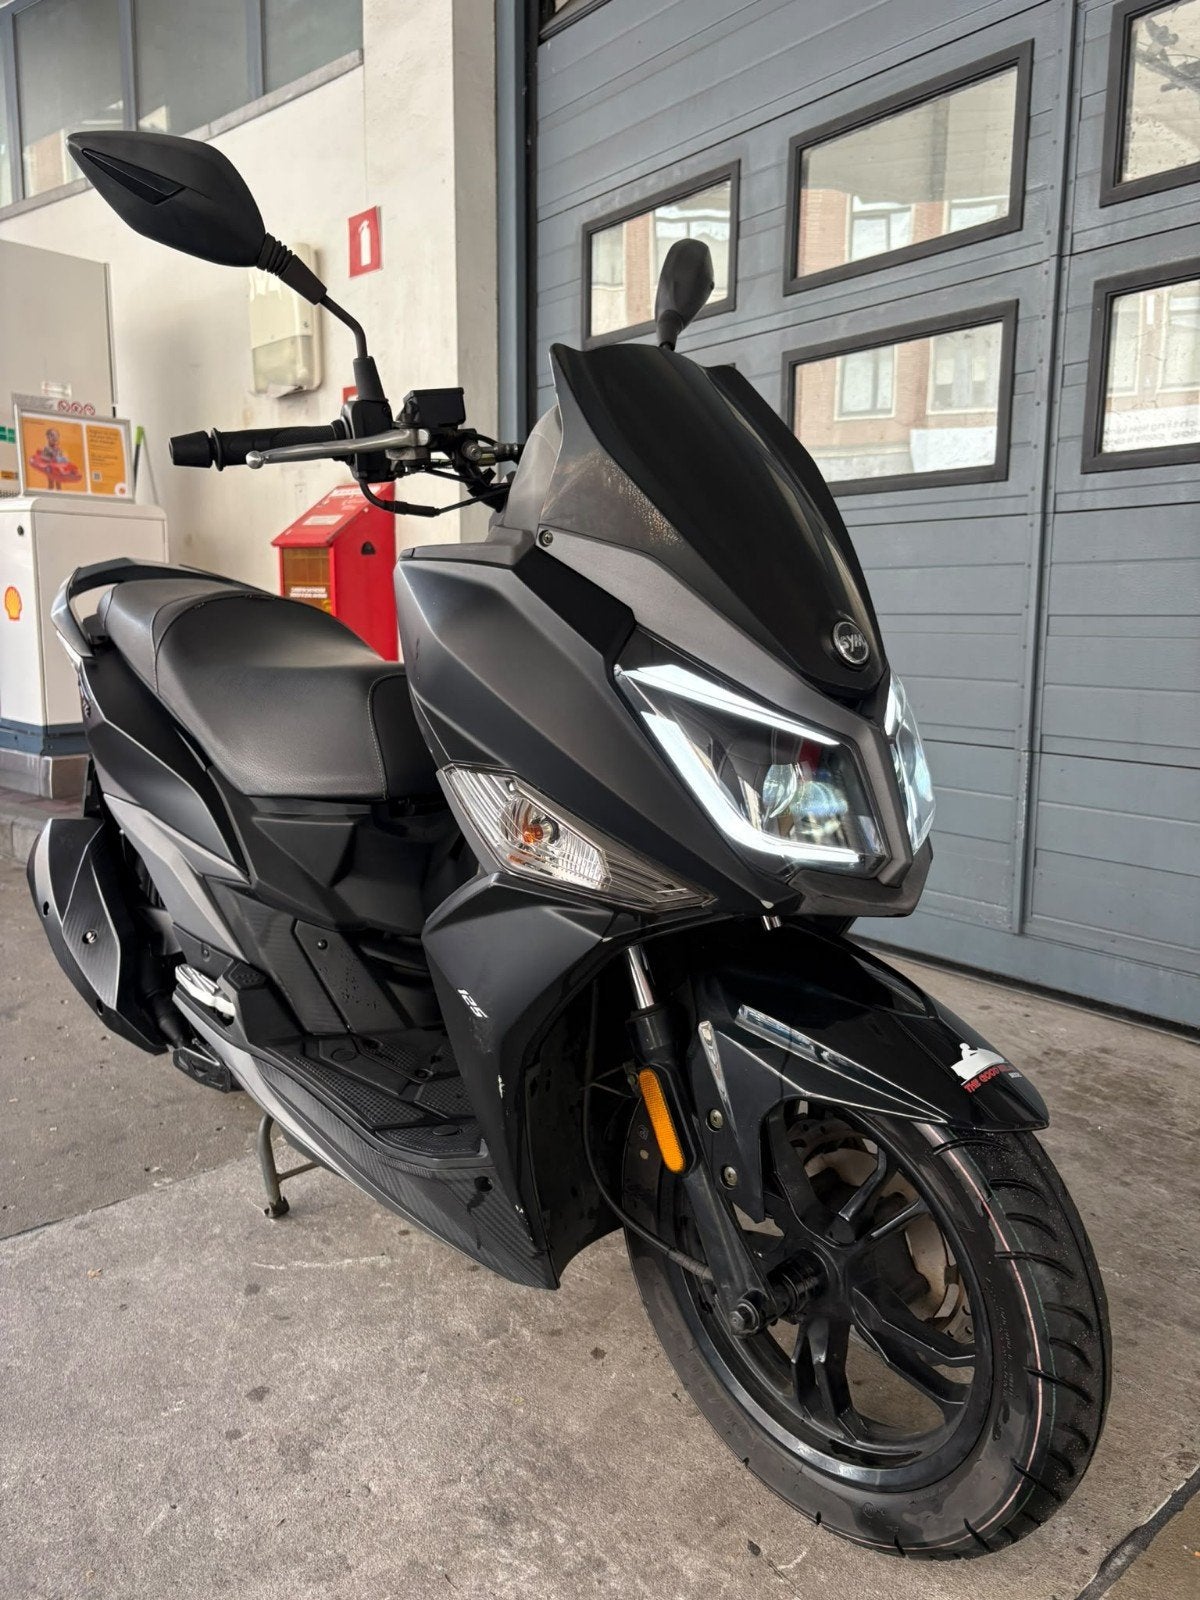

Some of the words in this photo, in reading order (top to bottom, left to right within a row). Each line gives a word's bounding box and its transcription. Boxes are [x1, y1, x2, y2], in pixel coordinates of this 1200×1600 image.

[840, 633, 863, 652] SYM
[457, 989, 488, 1018] 125
[963, 1078, 981, 1093] THE
